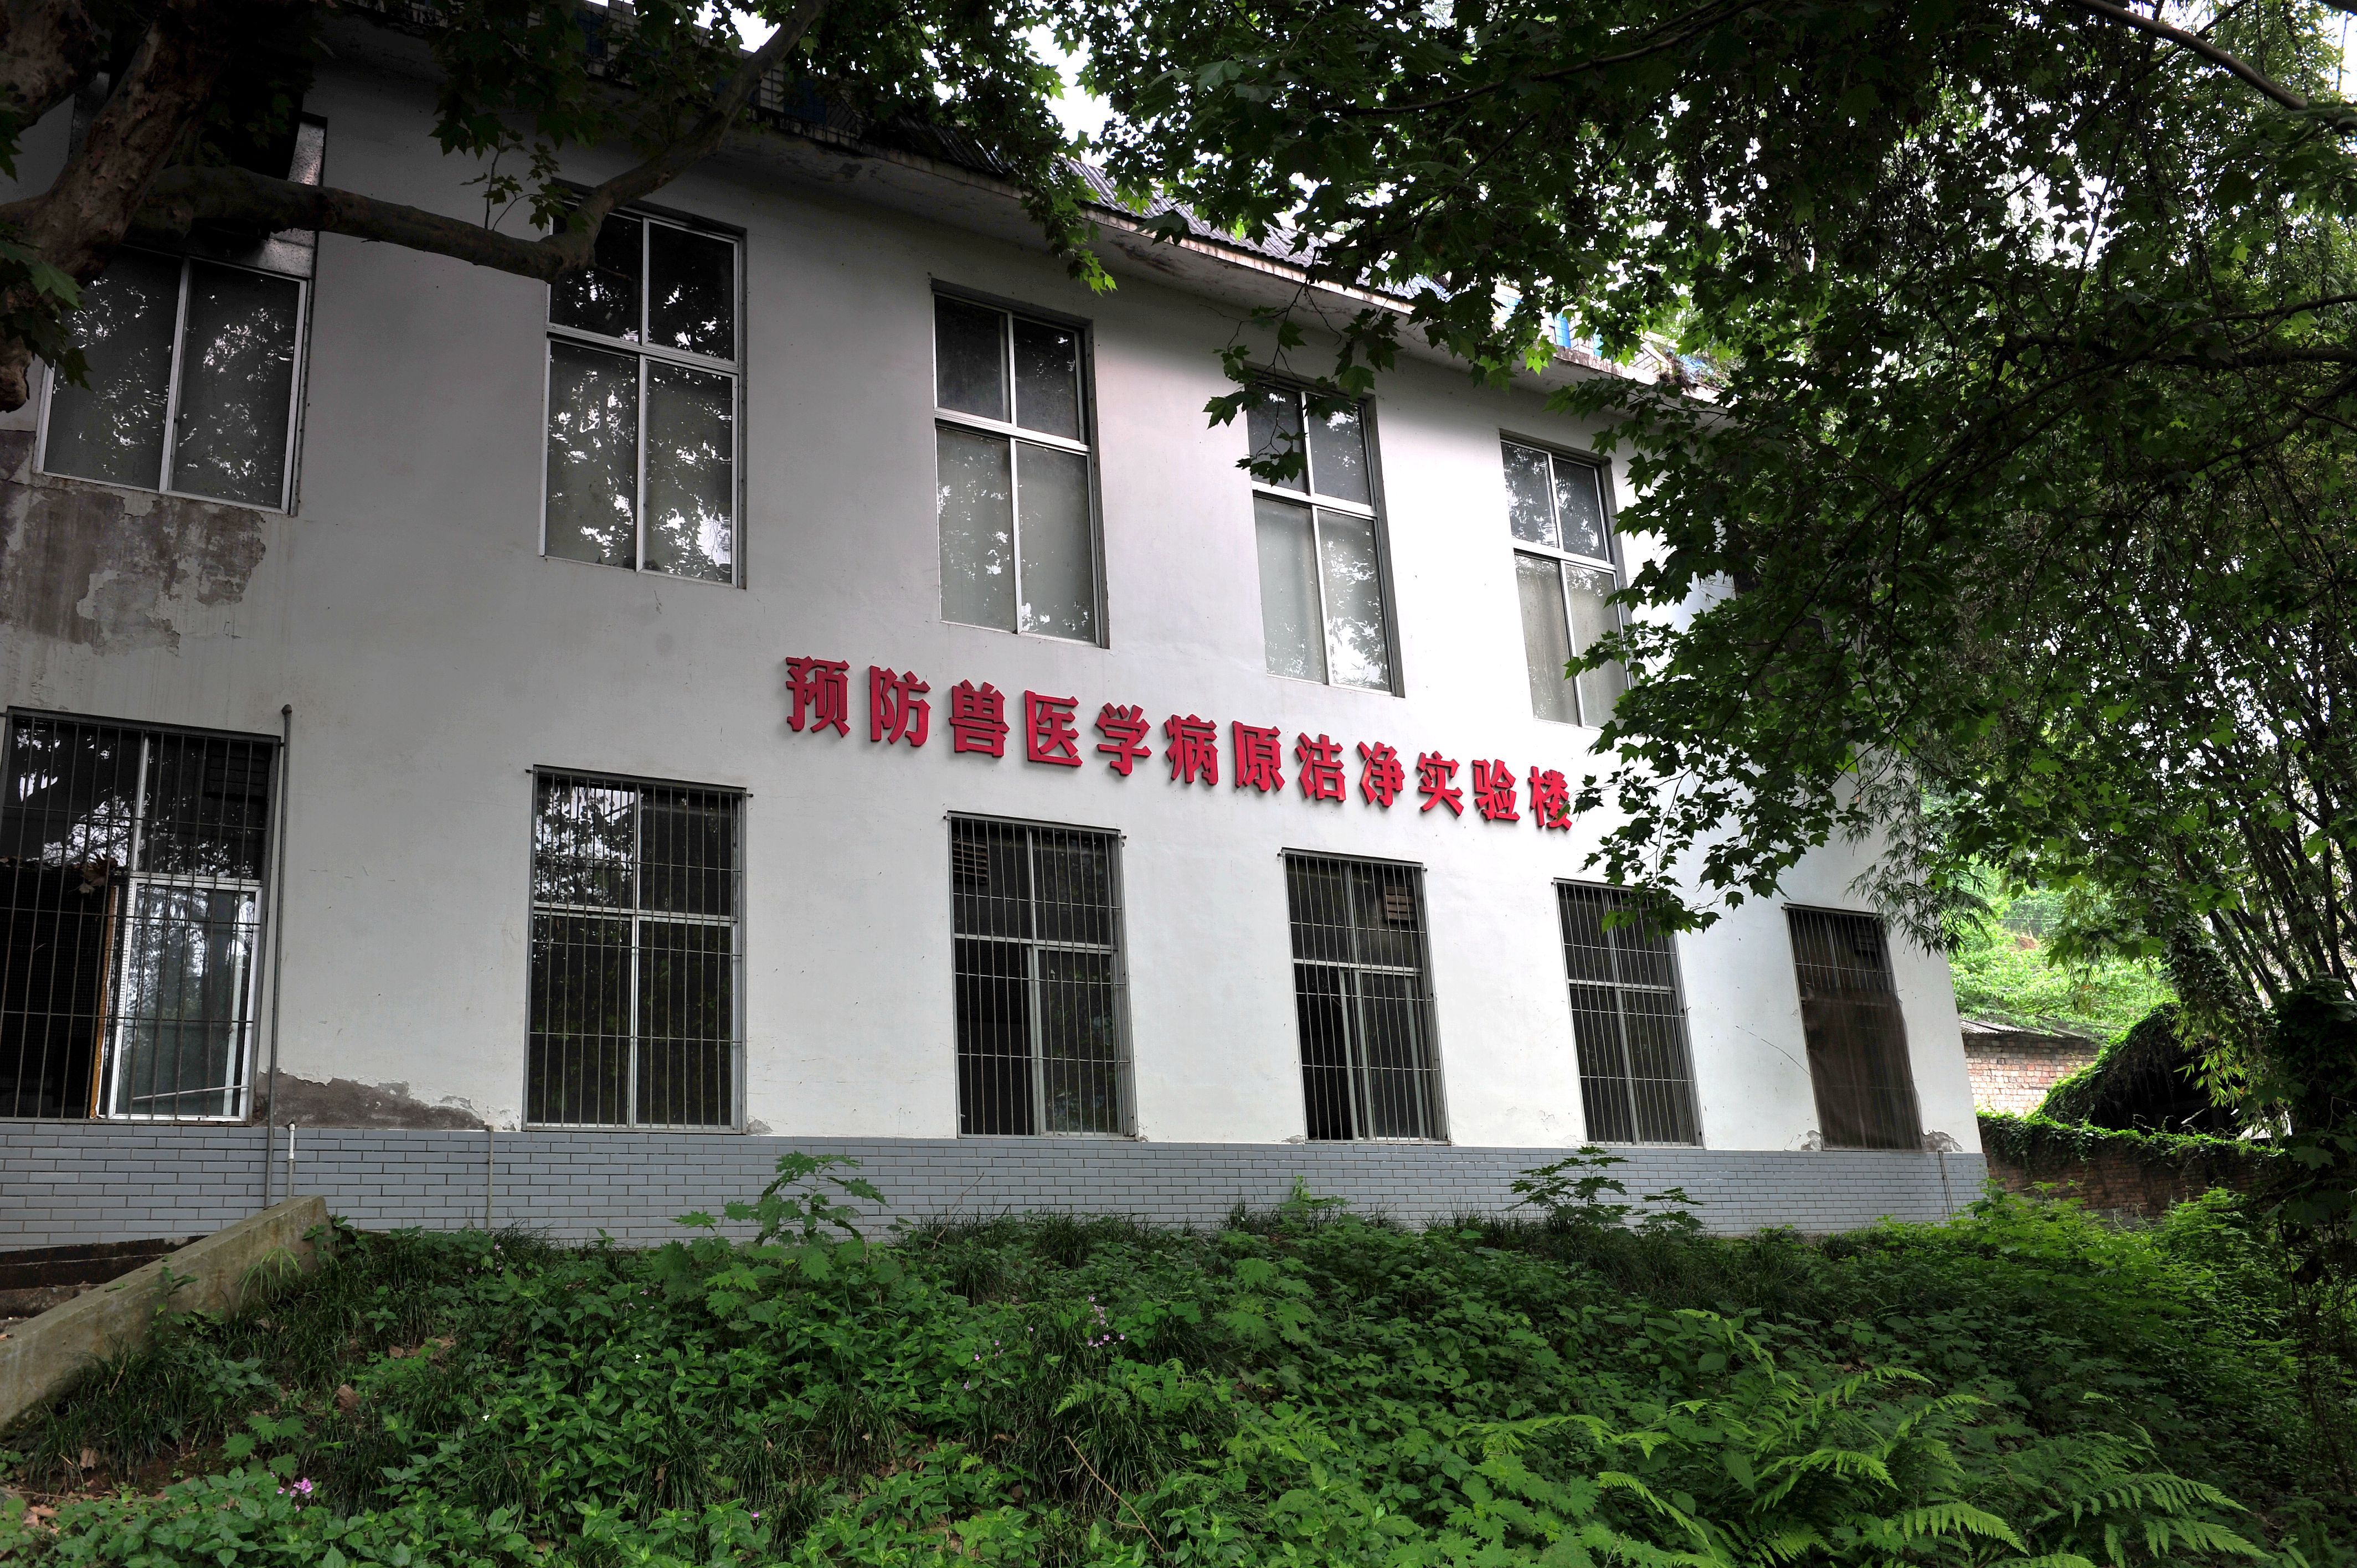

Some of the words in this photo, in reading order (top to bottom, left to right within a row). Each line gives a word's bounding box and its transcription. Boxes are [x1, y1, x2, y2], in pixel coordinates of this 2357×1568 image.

[785, 656, 1573, 831] 预防兽医学病原洁净实验楼
